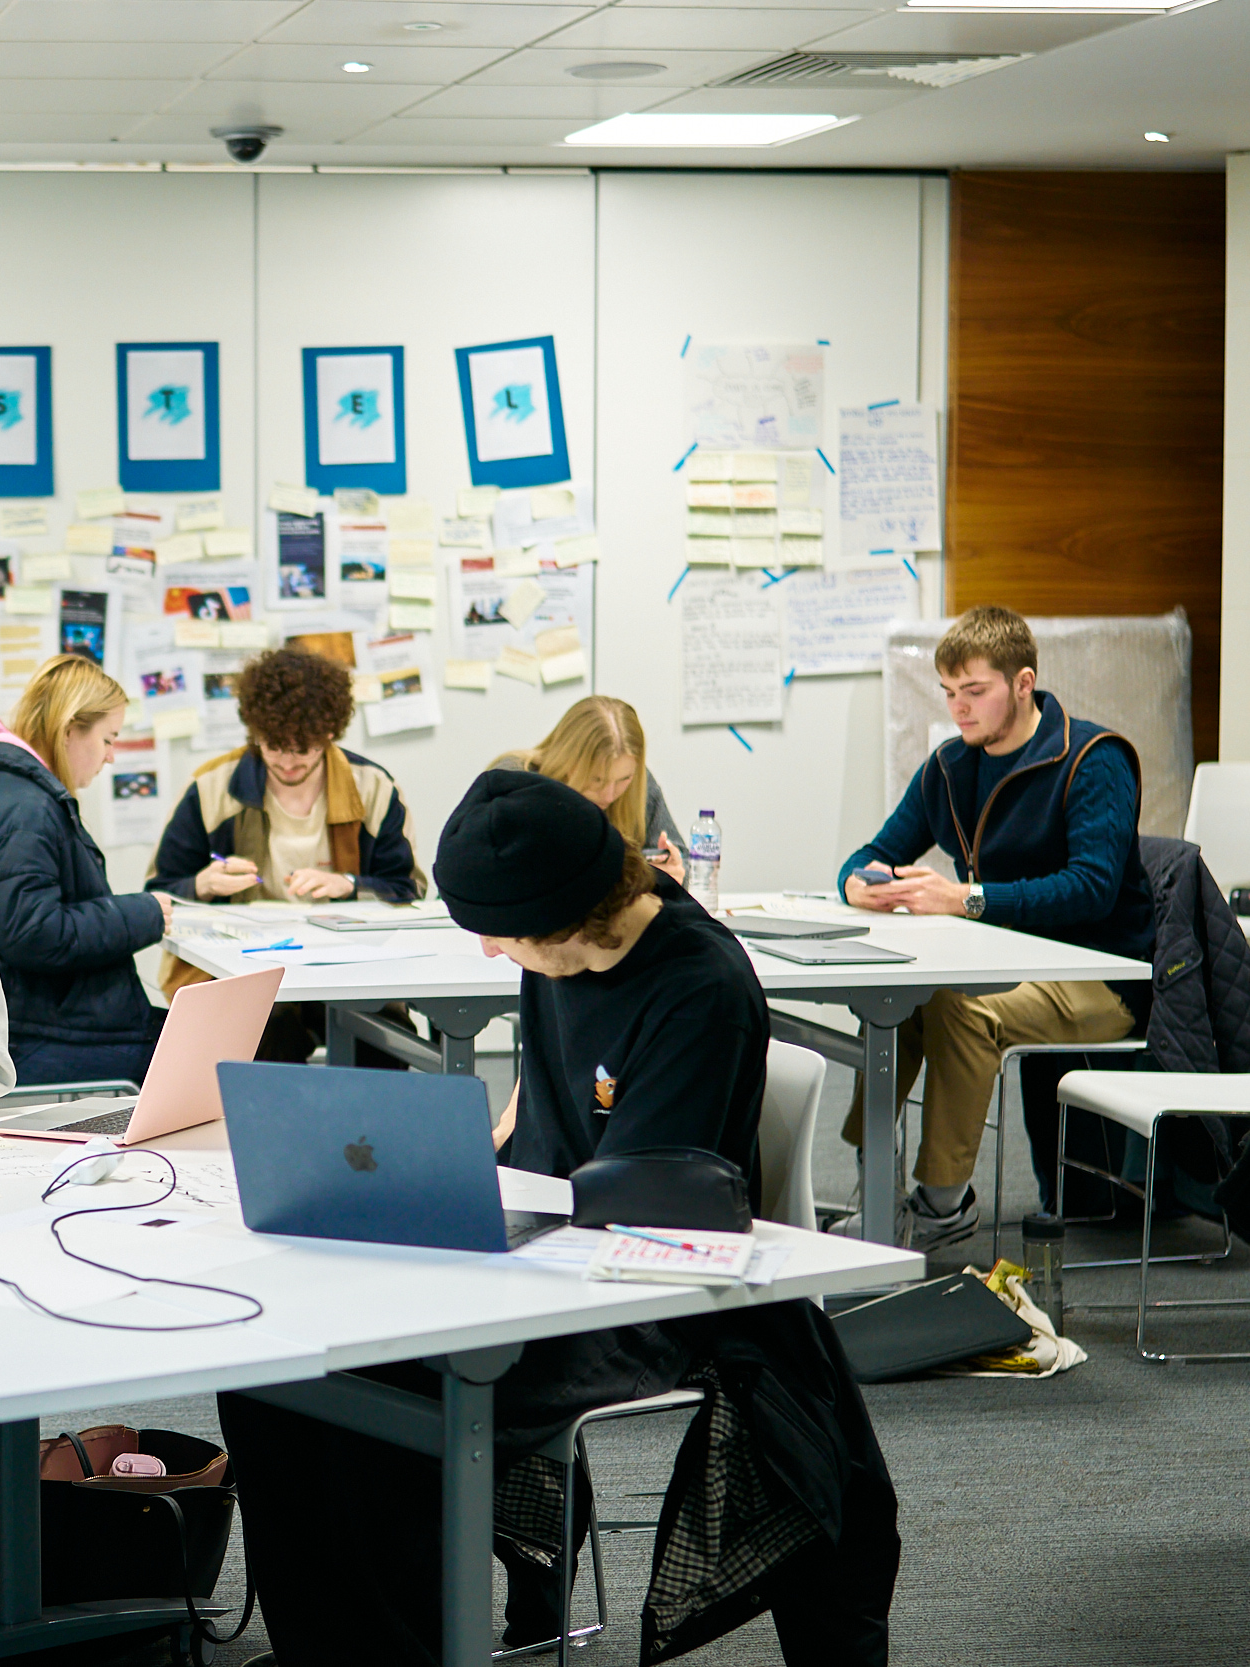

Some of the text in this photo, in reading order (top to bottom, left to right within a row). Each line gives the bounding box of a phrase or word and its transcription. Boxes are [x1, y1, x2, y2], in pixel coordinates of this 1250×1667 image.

[160, 389, 175, 411] T
[351, 394, 364, 415] E
[504, 390, 518, 410] L
